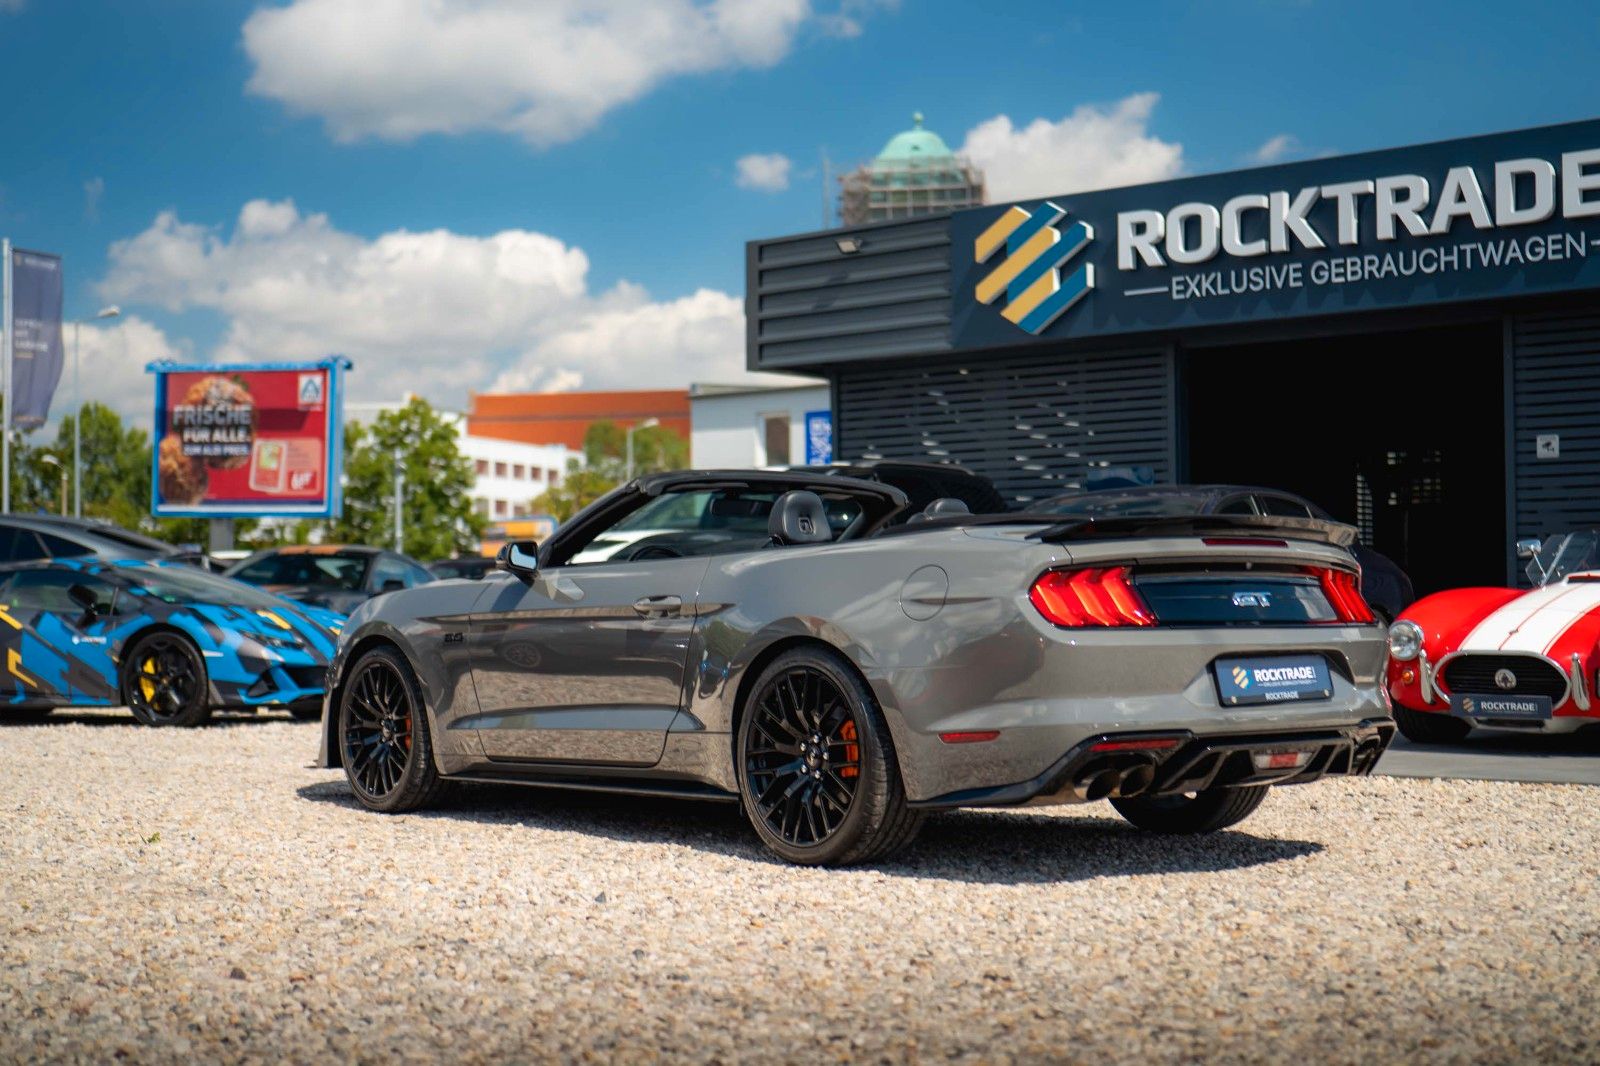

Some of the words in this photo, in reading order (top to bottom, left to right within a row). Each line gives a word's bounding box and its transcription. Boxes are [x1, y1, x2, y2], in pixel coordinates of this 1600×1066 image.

[1116, 148, 1600, 271] ROCKTRADE
[1171, 262, 1304, 301] EXKLUSIVE
[1311, 231, 1587, 285] GEBRAUCHTWAGEN
[173, 404, 252, 426] FRISCHE
[1232, 592, 1272, 608] GT
[1253, 666, 1314, 682] ROCKTRADE
[1264, 691, 1300, 701] ROCKTRADE
[1480, 701, 1536, 712] ROCKTRADE
